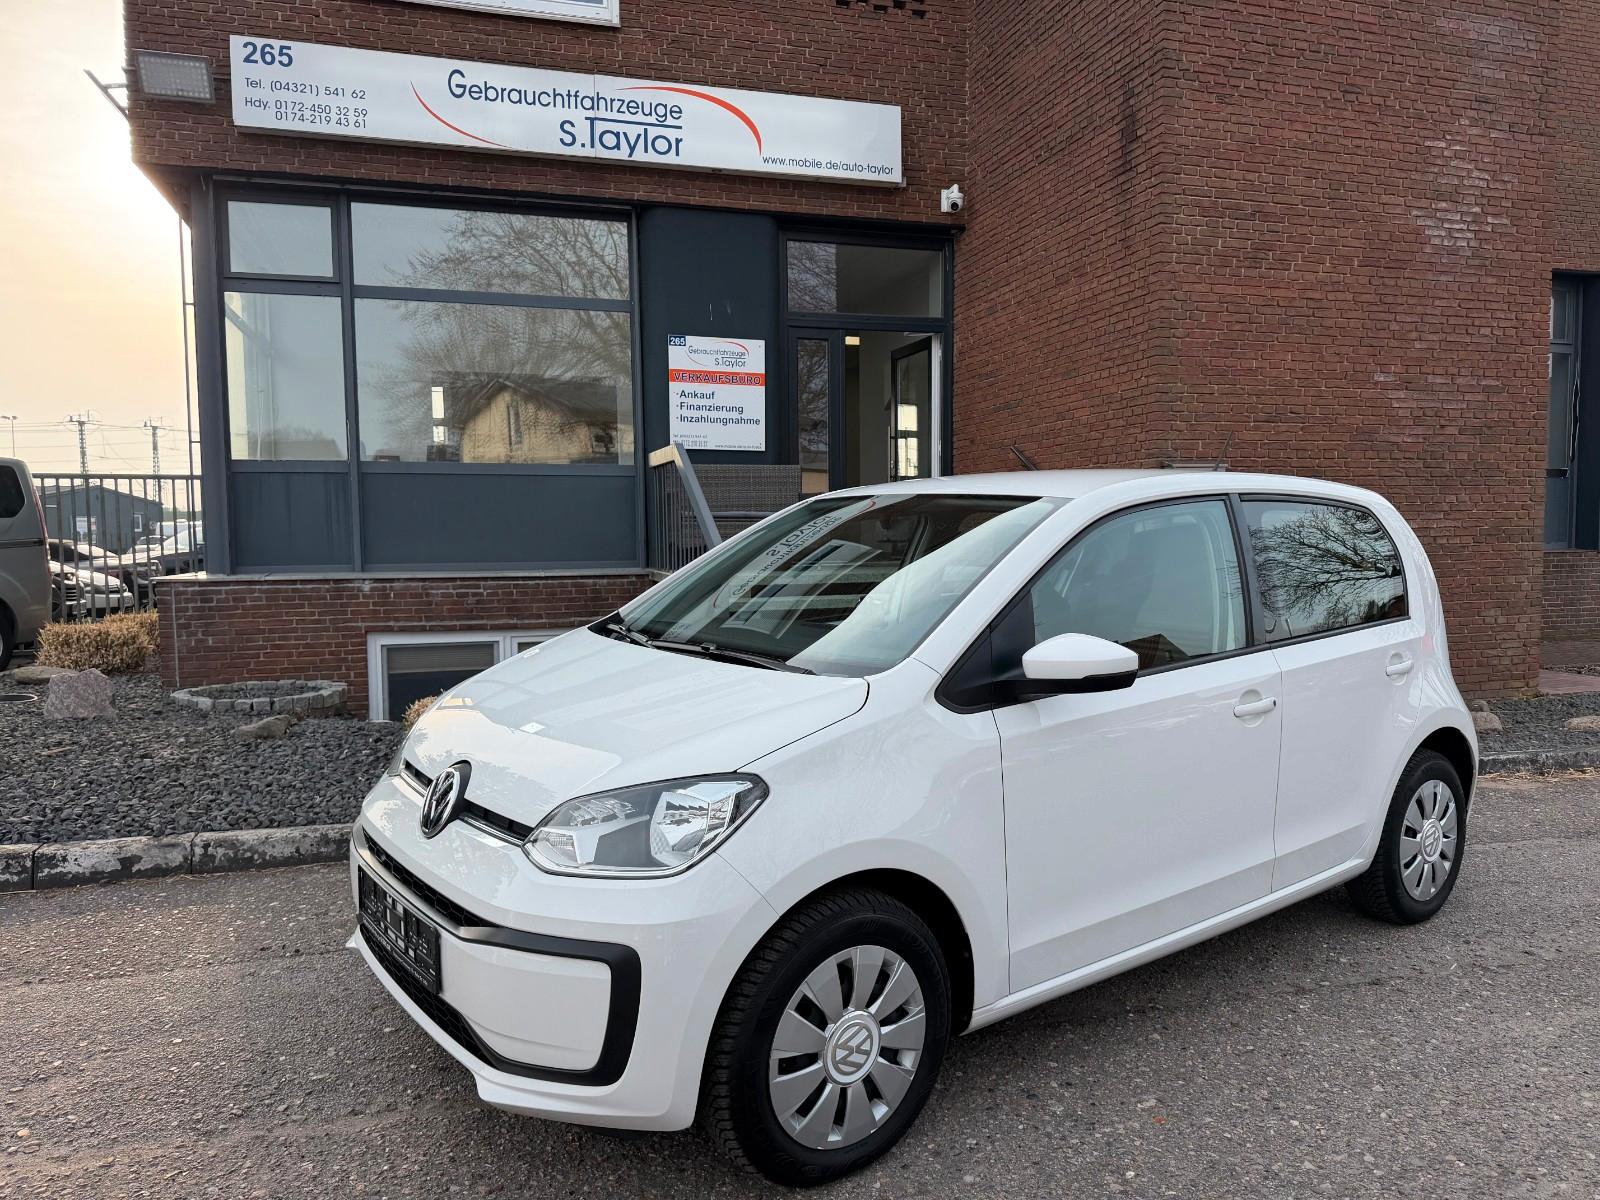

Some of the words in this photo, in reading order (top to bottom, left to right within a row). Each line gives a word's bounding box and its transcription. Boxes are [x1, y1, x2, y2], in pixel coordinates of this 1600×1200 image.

[242, 41, 293, 67] 265
[245, 77, 265, 89] Tel.
[271, 80, 319, 96] (04321)
[324, 86, 345, 97] 541
[351, 89, 366, 99] 62
[447, 69, 683, 122] Gebrauchtfahrzeuge
[245, 97, 270, 110] Hdy.
[275, 100, 331, 114] 0172-450
[335, 106, 349, 116] 32
[353, 108, 368, 118] 59
[275, 111, 331, 125] 0174-219
[335, 117, 350, 127] 43
[354, 118, 366, 128] 61
[559, 116, 683, 157] S.Taylor
[762, 156, 894, 175] www.mobile.de/auto-taylor
[670, 337, 685, 346] 265
[715, 357, 746, 368] S.Taylor
[680, 390, 715, 400] Ankauf
[680, 402, 744, 414] Finanzierung
[680, 414, 761, 426] Inzahlungnahme
